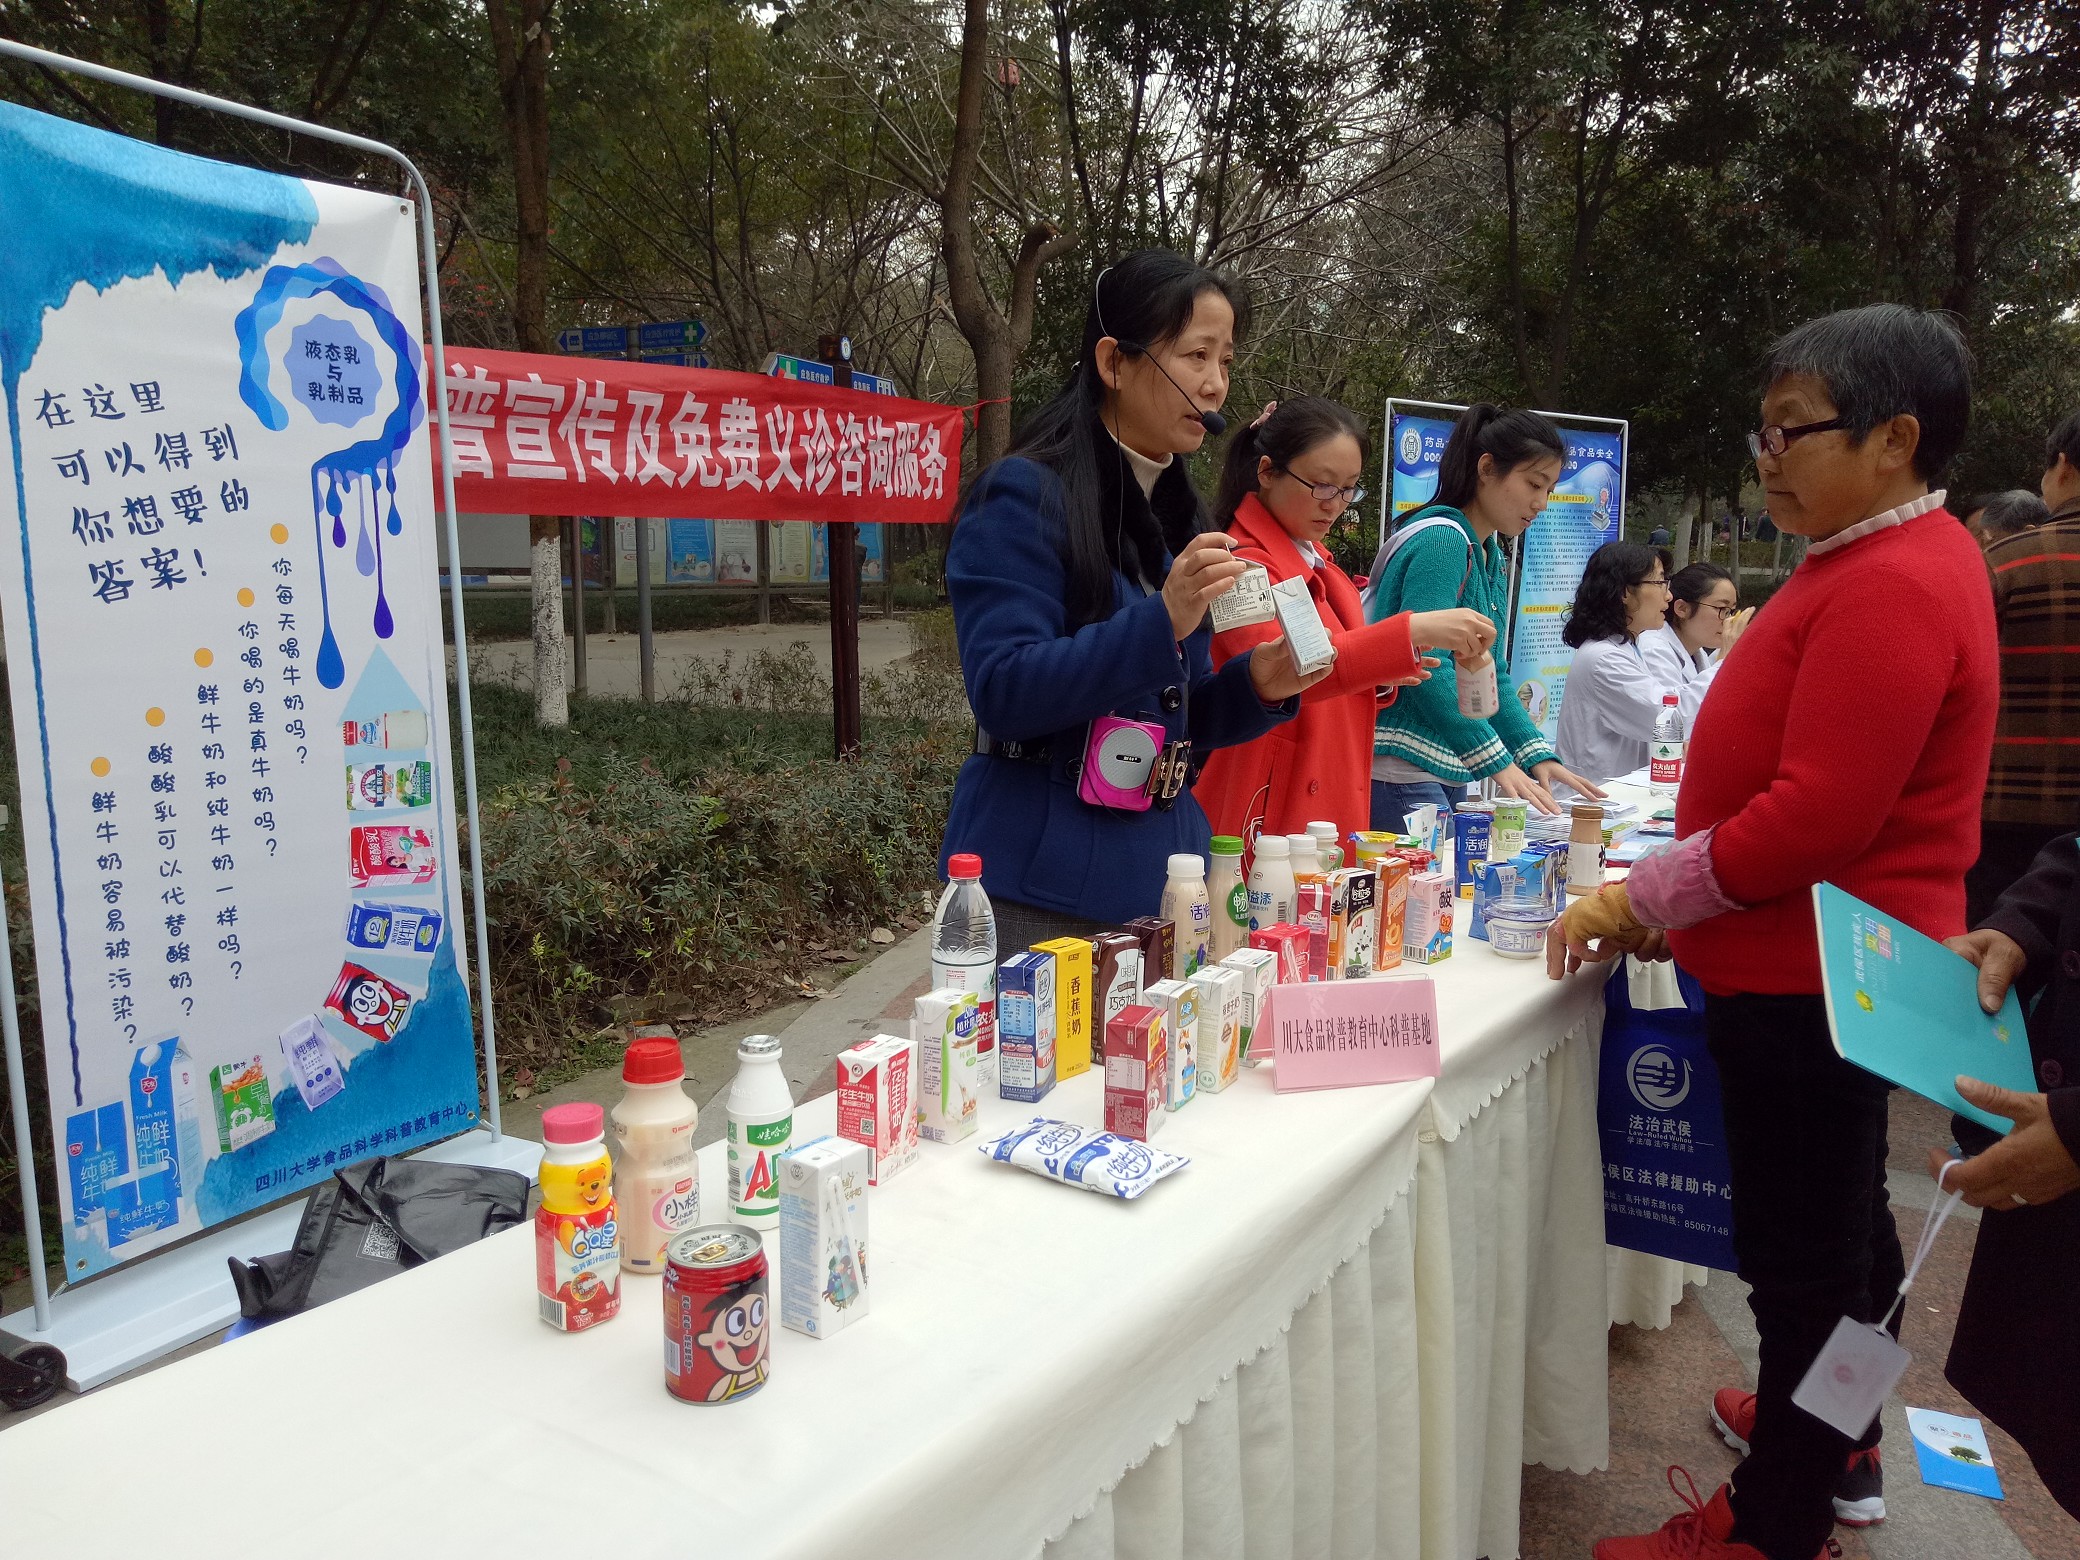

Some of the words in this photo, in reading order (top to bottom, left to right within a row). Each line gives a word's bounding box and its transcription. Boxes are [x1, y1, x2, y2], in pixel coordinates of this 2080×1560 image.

[305, 340, 360, 365] 液态乳
[326, 365, 343, 382] 与
[34, 380, 166, 429] 在这里
[308, 382, 364, 405] 乳制品
[430, 360, 948, 501] 普宣传及免费义诊咨询服务
[52, 424, 239, 486] 可以得到
[72, 478, 249, 547] 你想要的
[365, 828, 382, 866] 酸酸乳
[1464, 838, 1488, 851] 活润
[1232, 892, 1249, 914] 畅
[1439, 886, 1453, 909] 酸
[397, 919, 418, 947] 鲜牛奶
[1071, 975, 1082, 1036] 香蕉奶
[1282, 1012, 1433, 1054] 川大食品科普教育中心科普基地
[838, 1087, 875, 1104] 花生牛奶
[891, 1067, 903, 1129] 花生牛奶
[136, 1118, 171, 1149] 纯鲜
[756, 1125, 790, 1141] 娃哈哈
[1628, 1114, 1692, 1138] 法治武侯
[1628, 1128, 1668, 1140] Law-Ruled
[1669, 1135, 1692, 1144] Wuhou
[255, 1101, 469, 1192] 四川大学食品科学科普教育中心
[80, 1157, 119, 1186] 纯鲜
[571, 1220, 619, 1260] QQ星
